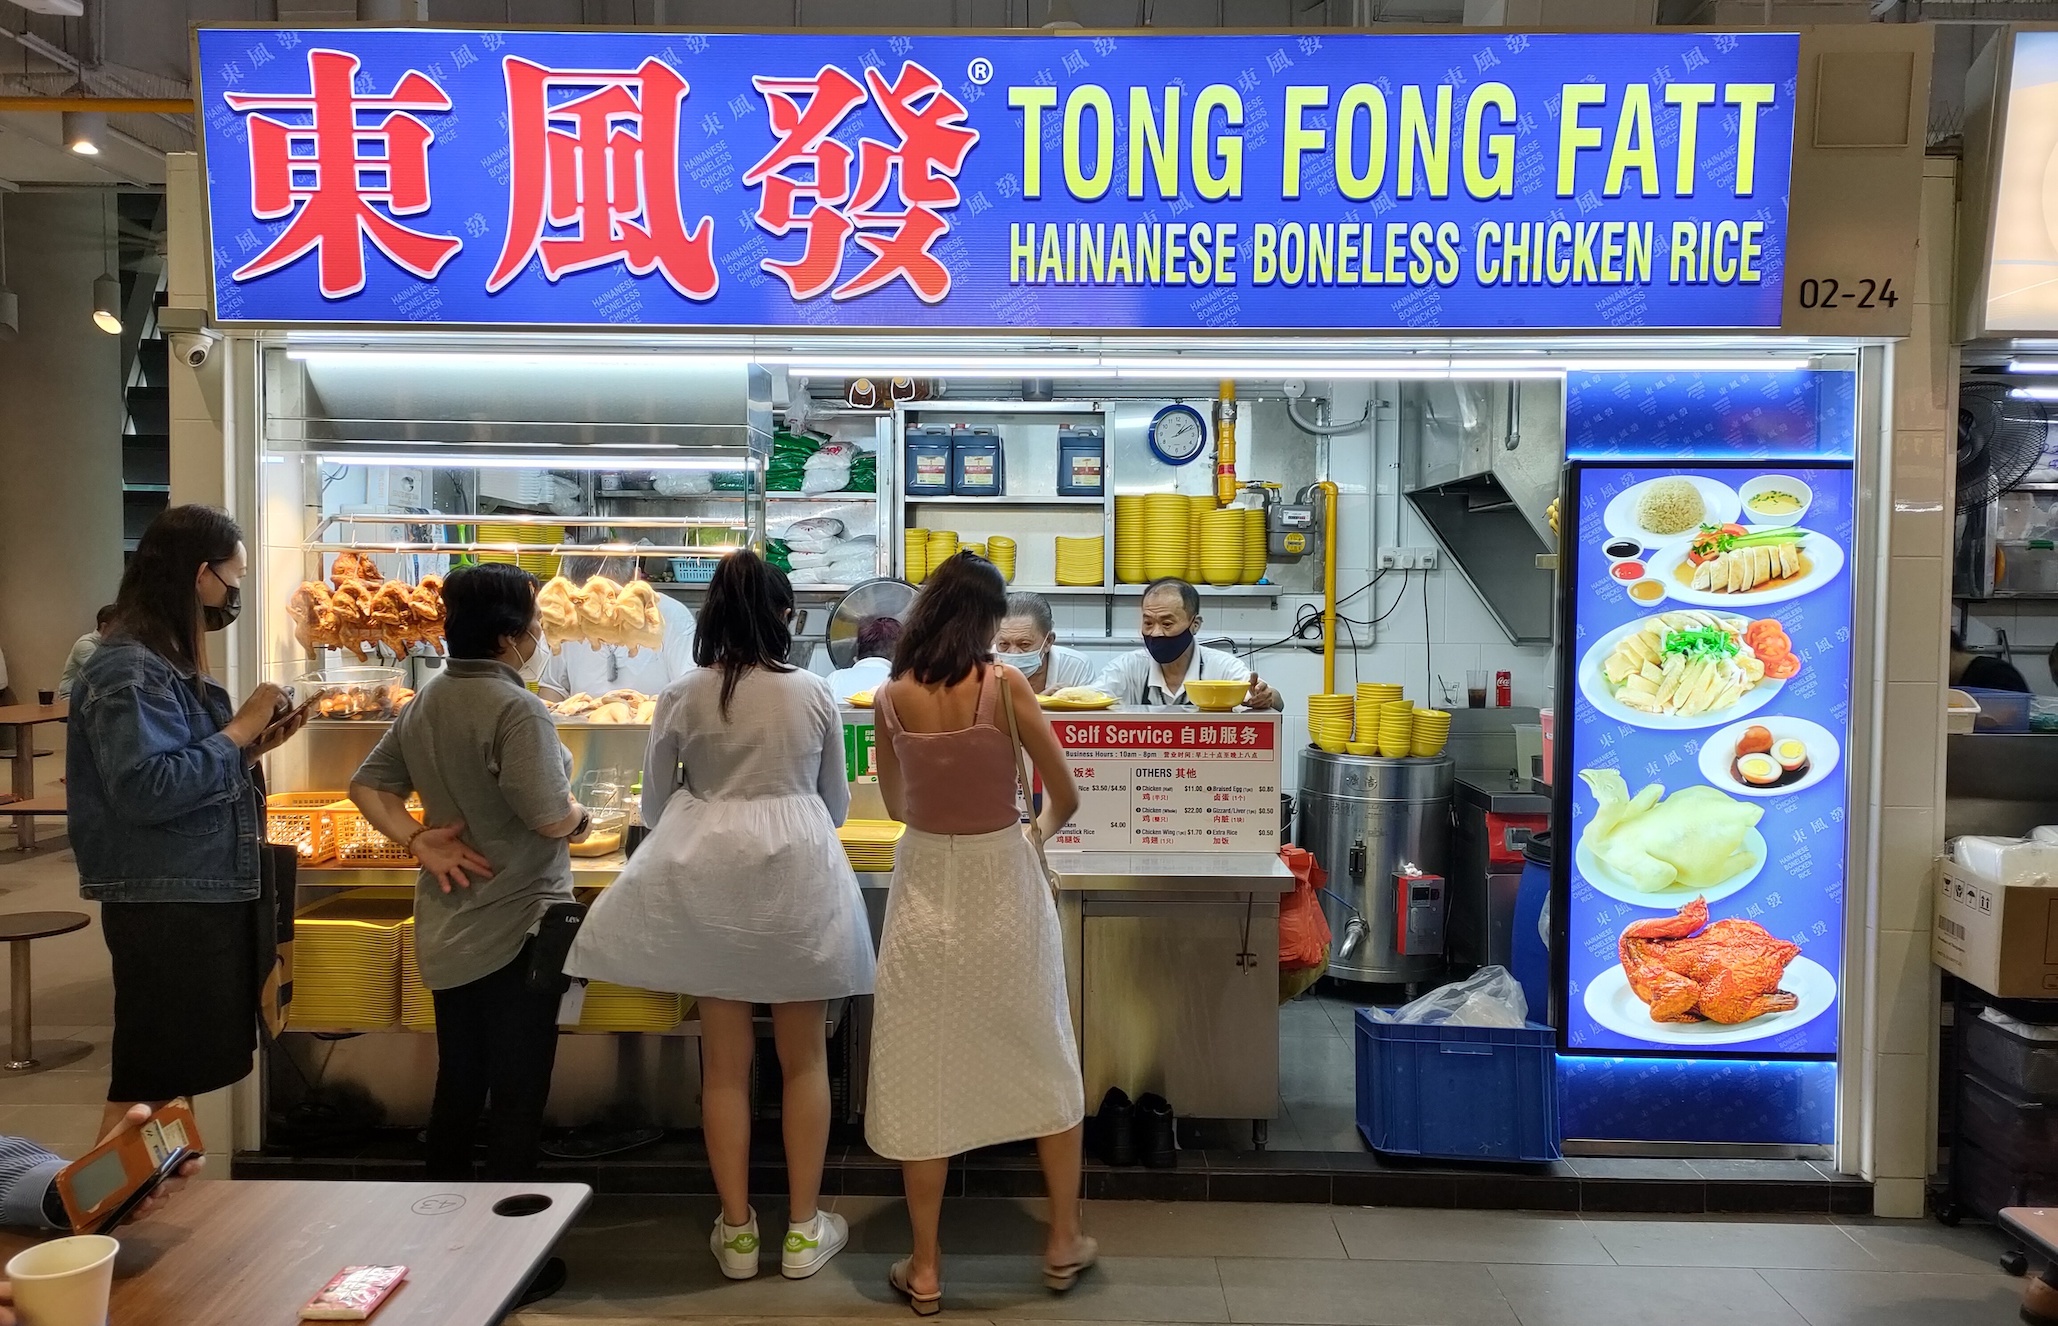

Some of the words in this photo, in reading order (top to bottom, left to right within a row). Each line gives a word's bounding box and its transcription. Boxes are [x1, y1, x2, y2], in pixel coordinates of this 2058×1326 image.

[1008, 84, 1244, 199] TONG
[1282, 82, 1517, 199] FONG
[1556, 83, 1776, 196] FATT
[682, 139, 728, 172] HAINANESE
[690, 151, 733, 182] BONELESS
[223, 48, 980, 304] 東風發
[699, 163, 735, 189] CHICKEN
[714, 177, 734, 195] RICE
[1522, 178, 1543, 195] RICE
[720, 234, 765, 266] HAINANESE
[727, 245, 769, 275] BONELESS
[1010, 222, 1237, 286] HAINANESE
[1253, 222, 1460, 286] BONELESS
[1475, 221, 1653, 285] CHICKEN
[1669, 220, 1764, 284] RICE
[397, 285, 440, 315] BONELESS
[592, 277, 636, 309] HAINANESE
[598, 288, 641, 317] BONELESS
[1390, 283, 1437, 312] HAINANESE
[1595, 280, 1643, 312] HAINANESE
[1800, 278, 1899, 308] 02-24
[609, 300, 643, 323] CHICKEN
[997, 291, 1039, 321] BONELESS
[1196, 291, 1239, 321] BONELESS
[1206, 303, 1241, 328] CHICKEN
[1398, 291, 1441, 321] BONELESS
[1407, 303, 1443, 328] CHICKEN
[1602, 291, 1646, 321] BONELESS
[1611, 302, 1648, 327] CHICKEN
[1065, 725, 1100, 744] Self
[1105, 725, 1173, 744] Service
[1181, 726, 1259, 745] 自助服务
[1143, 751, 1157, 759] 8pm
[1073, 767, 1095, 779] 饭类
[1136, 768, 1172, 778] OTHERS
[1175, 768, 1197, 779] 其他
[1780, 845, 1810, 865] HAINANESE
[1784, 852, 1812, 871] BONELESS
[1790, 860, 1813, 876] CHICKEN
[1798, 869, 1812, 880] RICE
[1583, 927, 1614, 947] HAINANESE
[1588, 934, 1616, 953] BONELESS
[1594, 942, 1617, 958] CHICKEN
[1602, 951, 1616, 961] RICE
[419, 1199, 457, 1210] 43
